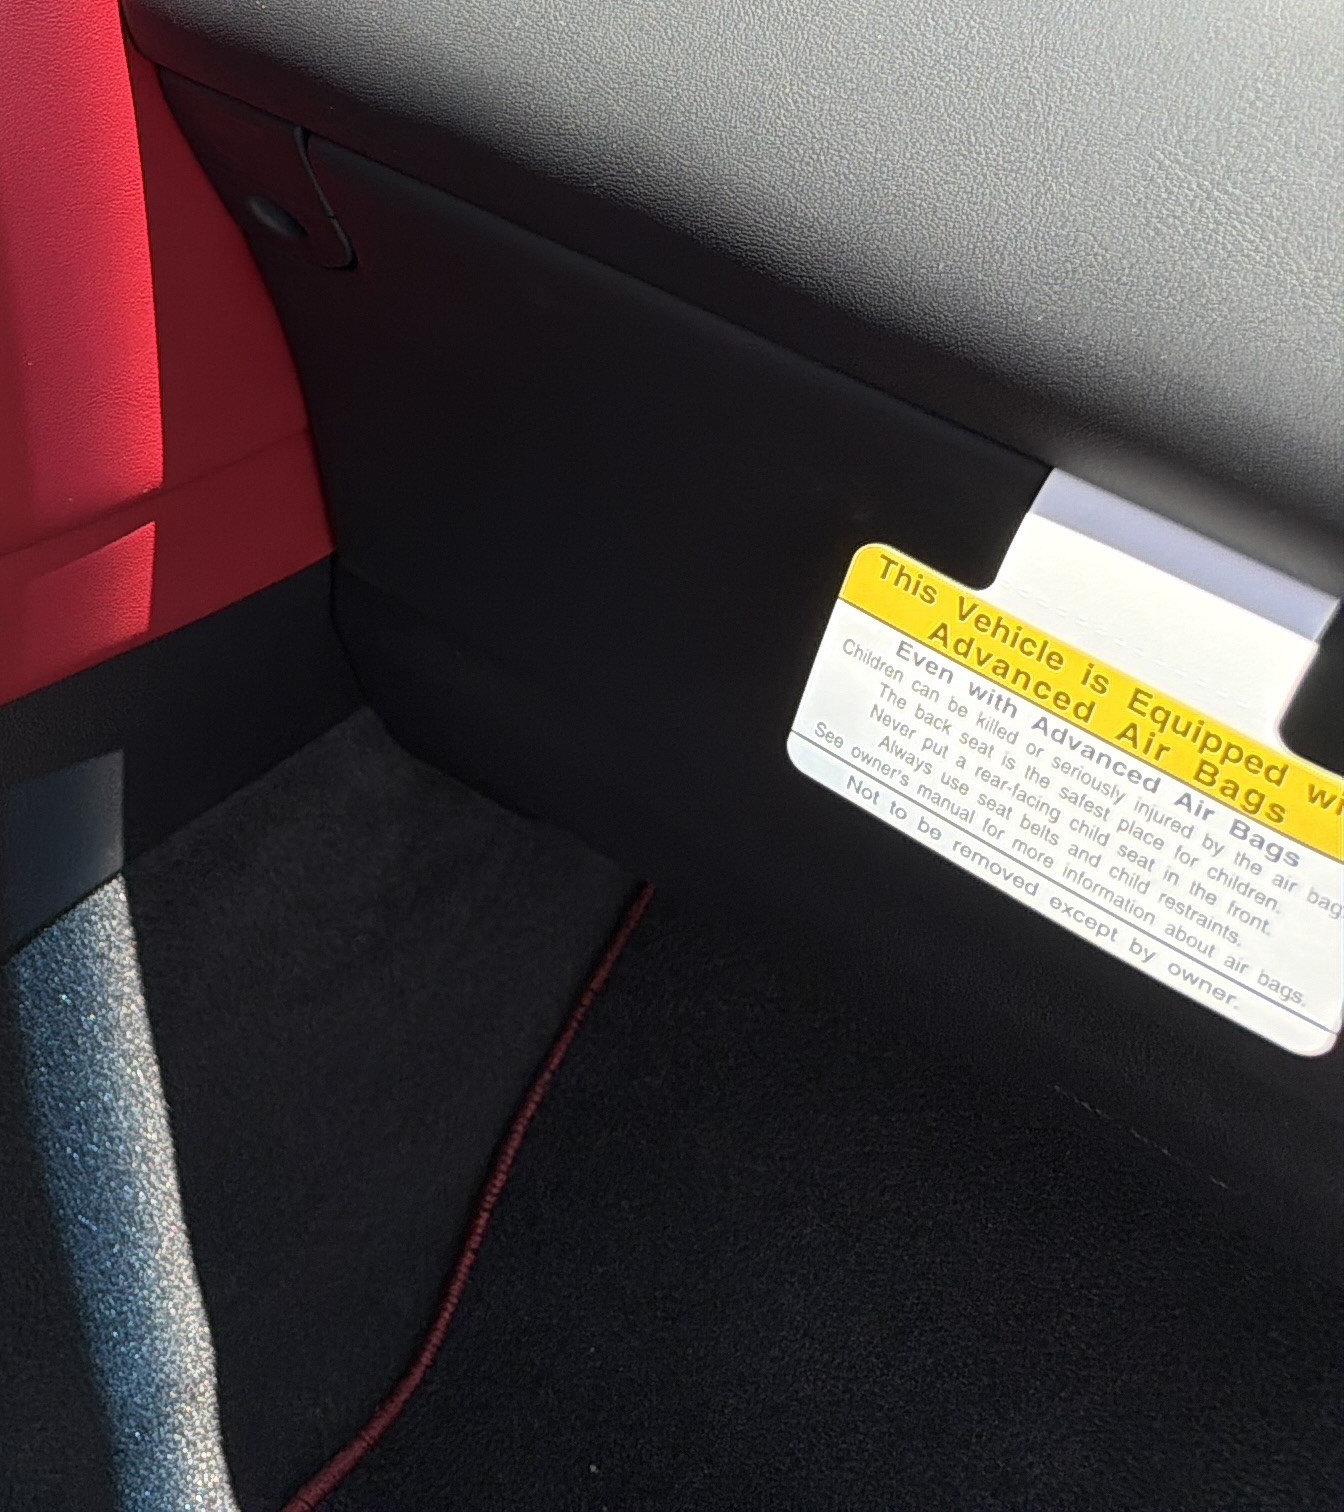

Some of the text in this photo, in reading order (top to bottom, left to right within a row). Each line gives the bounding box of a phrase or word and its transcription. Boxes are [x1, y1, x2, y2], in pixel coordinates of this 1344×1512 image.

[842, 638, 1299, 893] Children can be killed or seriously injured by the air
[880, 554, 1289, 787] This Vehicle is Equipped
[895, 639, 1301, 868] Even with Advanced Air Bags
[927, 621, 1286, 824] Advanced Air Bags
[814, 720, 1307, 1008] See owner's manual for more information about air bags.
[846, 774, 1241, 1011] Not to be removed except by owner.
[869, 703, 1272, 937] Never put a rear-facing child seat in the front.
[877, 735, 1243, 948] Always use seat belts and child restraints.
[878, 681, 1281, 914] The back seat is the safest place for children.
